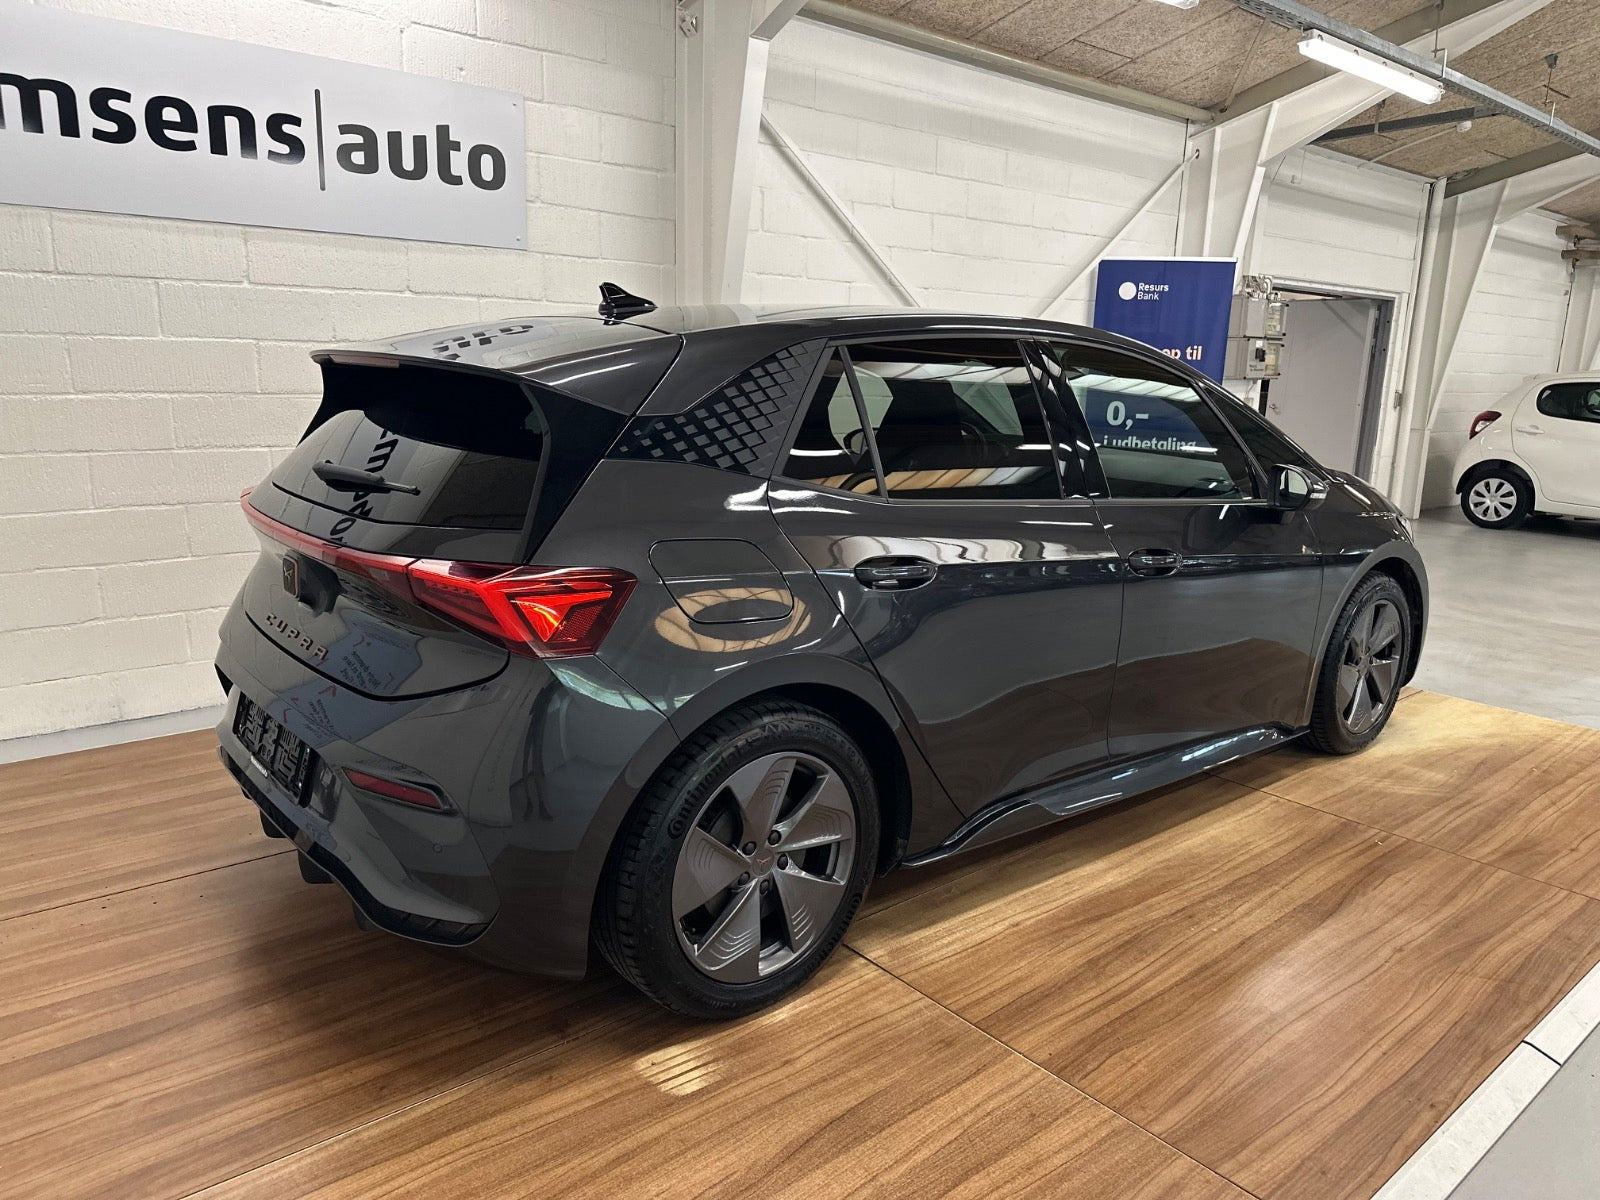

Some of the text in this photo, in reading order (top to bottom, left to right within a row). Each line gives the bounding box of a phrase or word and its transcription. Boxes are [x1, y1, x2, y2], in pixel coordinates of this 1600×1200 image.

[1138, 283, 1169, 292] Resurs
[1137, 291, 1160, 301] Bank
[1185, 345, 1203, 360] til
[265, 613, 329, 660] CUPRA
